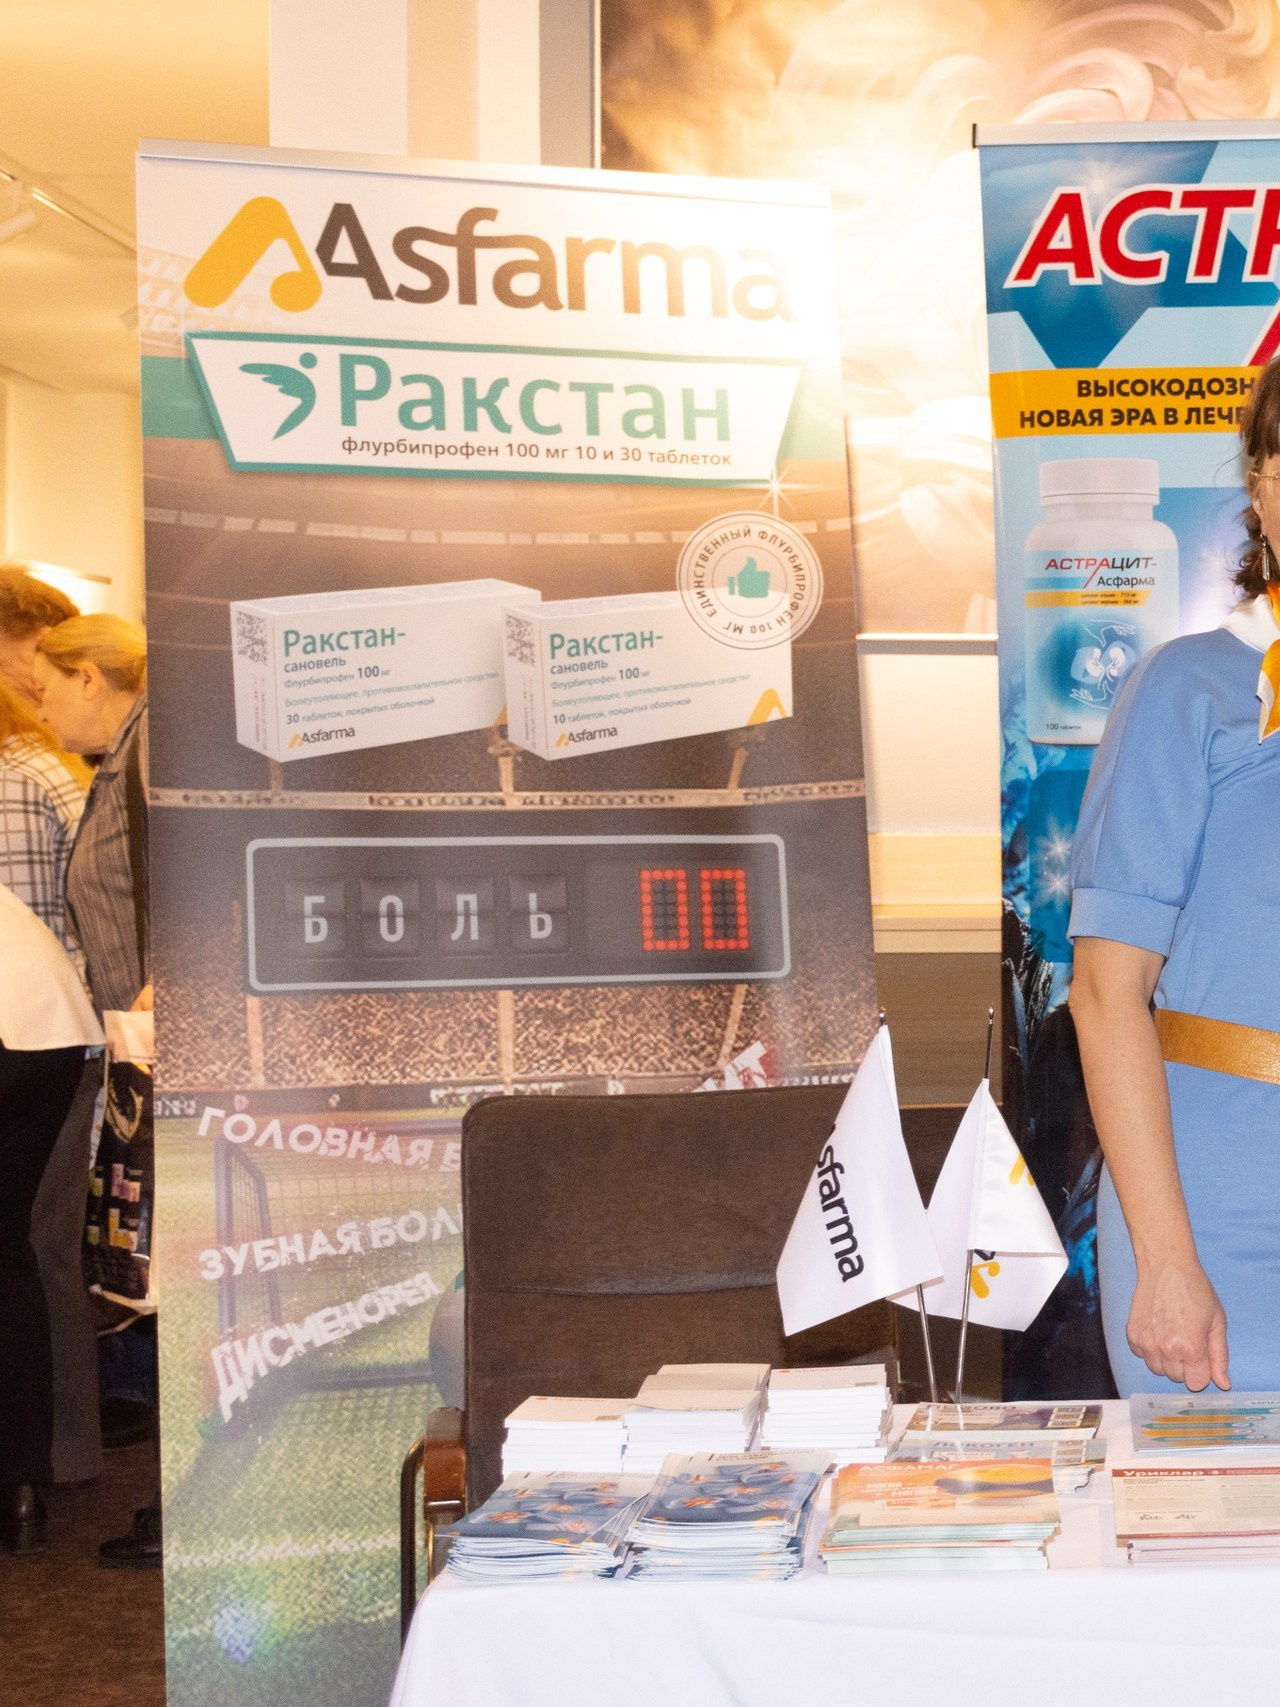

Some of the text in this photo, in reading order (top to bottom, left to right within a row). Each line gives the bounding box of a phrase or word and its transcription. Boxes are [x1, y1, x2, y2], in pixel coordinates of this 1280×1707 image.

[315, 202, 797, 323] Asfarma
[338, 352, 731, 443] Ракстан
[1077, 377, 1257, 400] ВЫСОКОДОЗН
[1020, 408, 1103, 429] НОВАЯ
[1110, 408, 1157, 427] ЭРА
[1163, 408, 1179, 425] В
[341, 434, 732, 466] флурбипрофен 100 мг 10 и 30 таблеток
[693, 524, 752, 618] ЕДИНСТВЕННЫЙ
[757, 529, 807, 628] ФЛУРБИПРОФЕН
[1097, 576, 1156, 589] Асфарма
[750, 621, 773, 635] 100
[283, 627, 407, 657] Ракстан-
[550, 629, 664, 660] Ракстан-
[284, 657, 347, 674] сановель
[357, 665, 380, 680] 100
[550, 659, 609, 676] сановель
[618, 667, 640, 681] 100
[286, 713, 300, 725] 30
[553, 713, 566, 725] 10
[302, 725, 356, 744] Asfarma
[567, 725, 618, 744] Asfarma
[303, 892, 554, 945] БОЛЬ
[197, 1106, 433, 1171] ГОЛОВНАЯ
[816, 1144, 866, 1283] sfarma
[198, 1219, 365, 1281] ЗУБНАЯ
[210, 1271, 441, 1423] ДИСМЕНОРЕЯ
